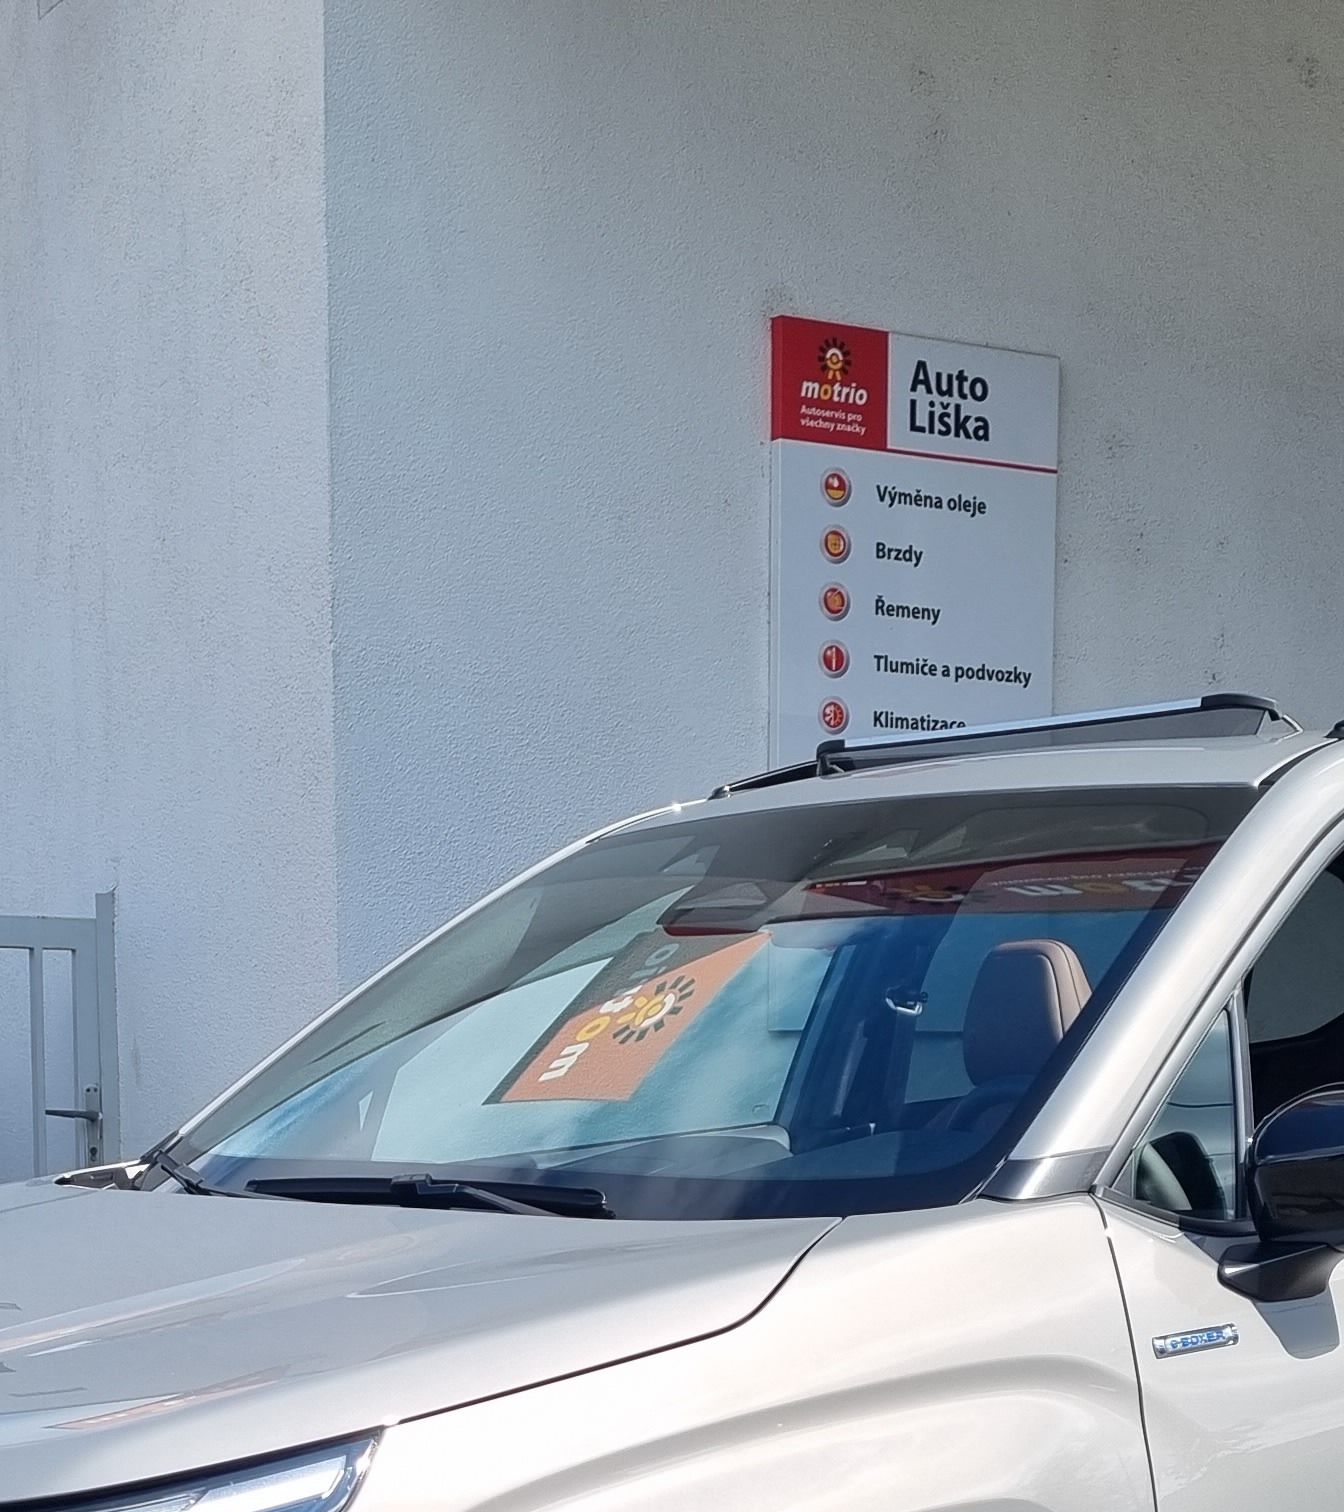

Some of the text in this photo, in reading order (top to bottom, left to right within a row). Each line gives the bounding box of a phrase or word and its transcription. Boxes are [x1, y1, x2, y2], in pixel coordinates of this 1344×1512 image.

[800, 381, 868, 405] motrio
[909, 359, 990, 402] Auto
[800, 404, 863, 423] Autoservis pro
[908, 398, 990, 442] Liška
[876, 484, 987, 518] Výměna oleje
[875, 542, 923, 568] Brzdy
[874, 595, 941, 625] Řemeny
[873, 655, 1032, 688] Tlumiče a podvozky
[1170, 1329, 1226, 1349] e-BOXER
